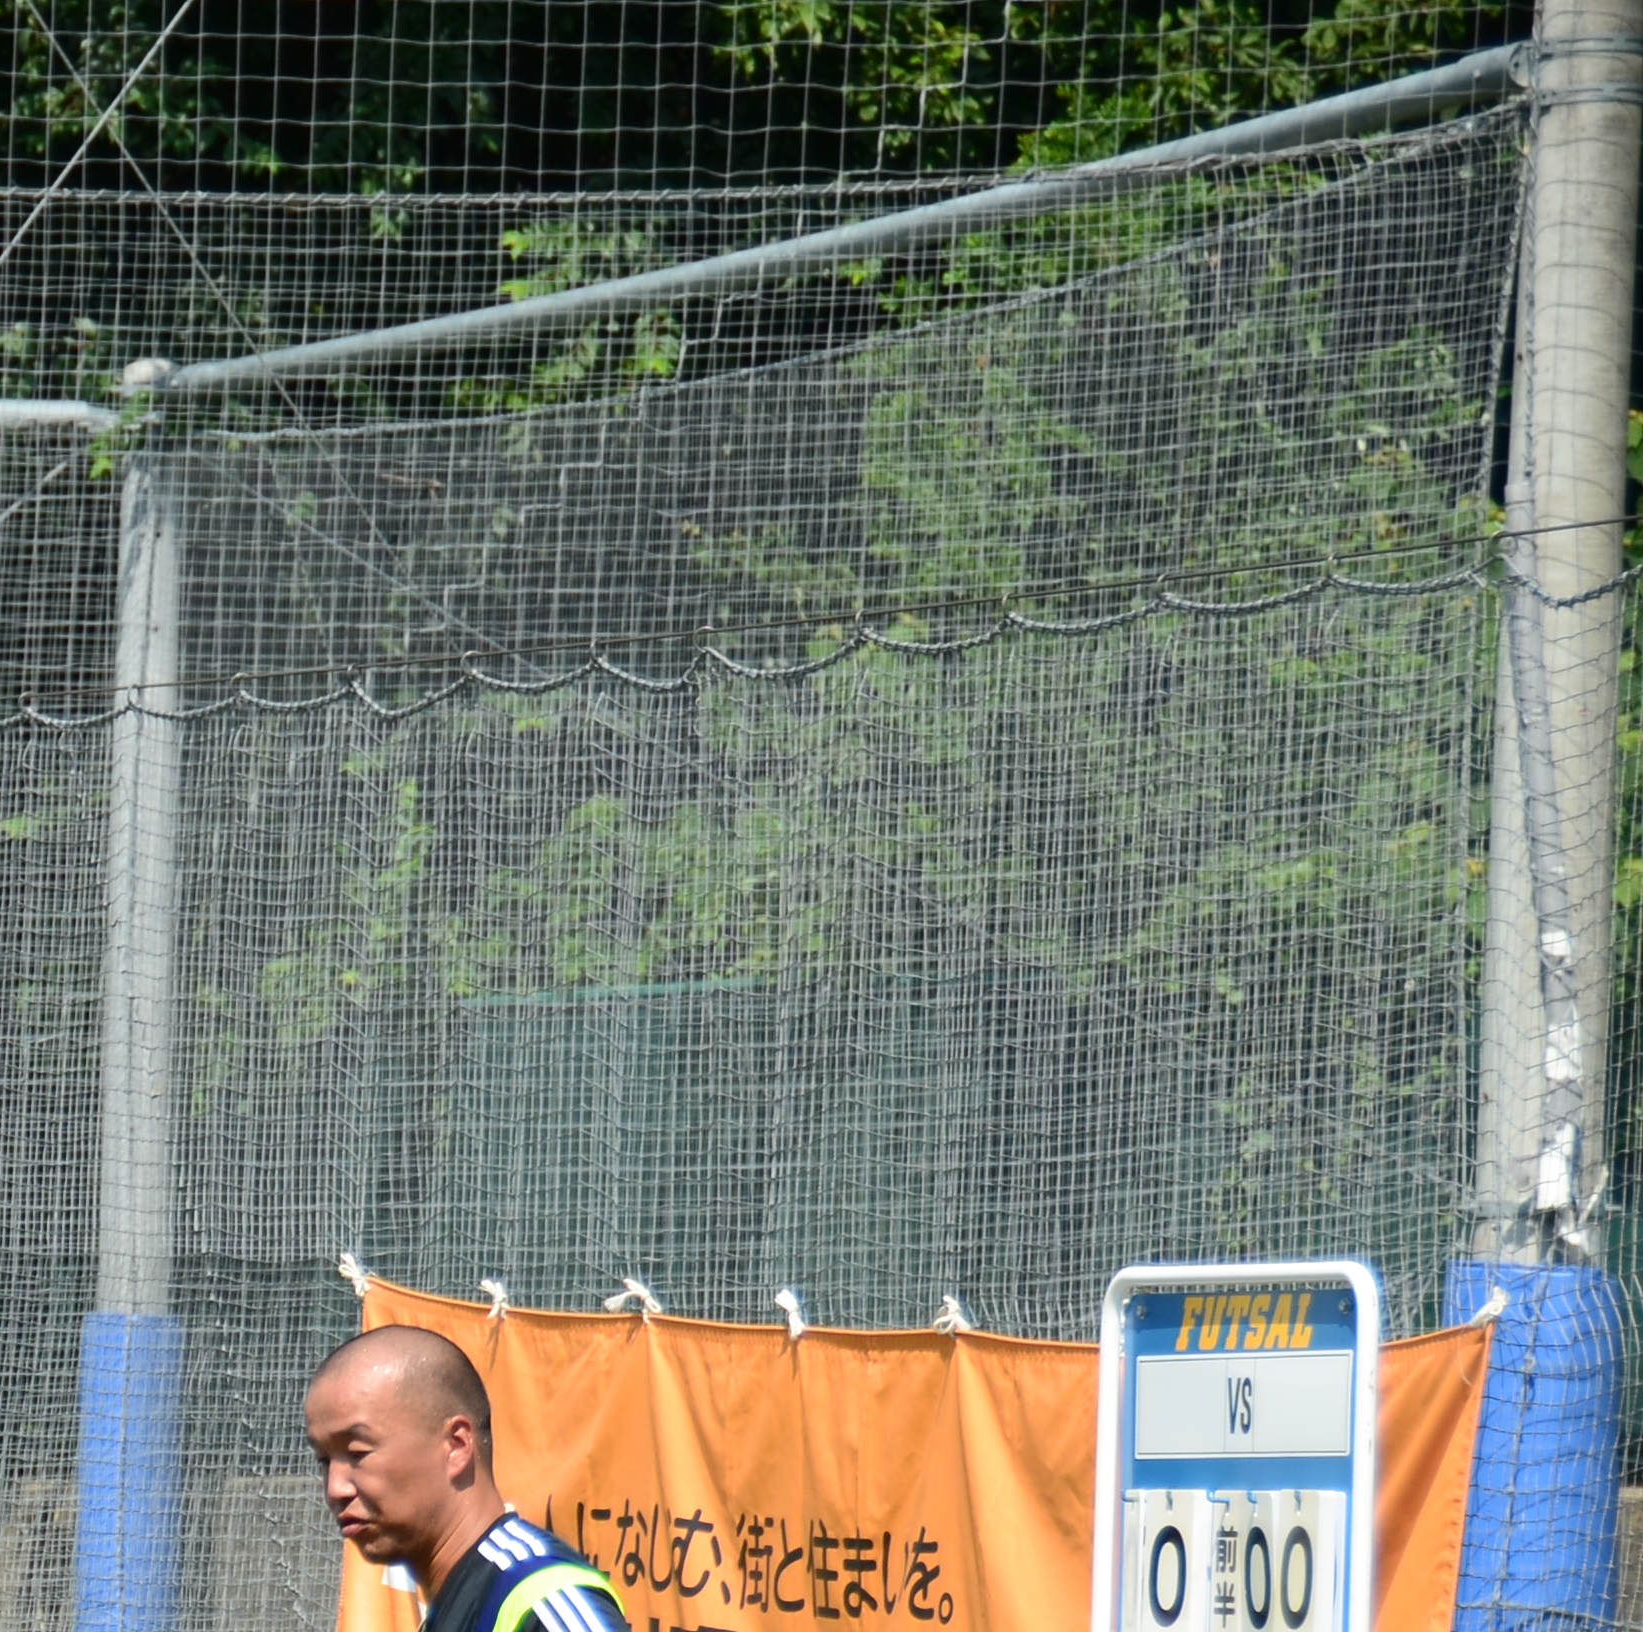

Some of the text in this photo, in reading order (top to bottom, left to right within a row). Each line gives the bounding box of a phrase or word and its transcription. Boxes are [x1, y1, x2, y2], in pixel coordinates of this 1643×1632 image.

[1175, 1292, 1313, 1351] FUTSAL
[1227, 1377, 1252, 1434] VS
[1213, 1525, 1239, 1629] 前半
